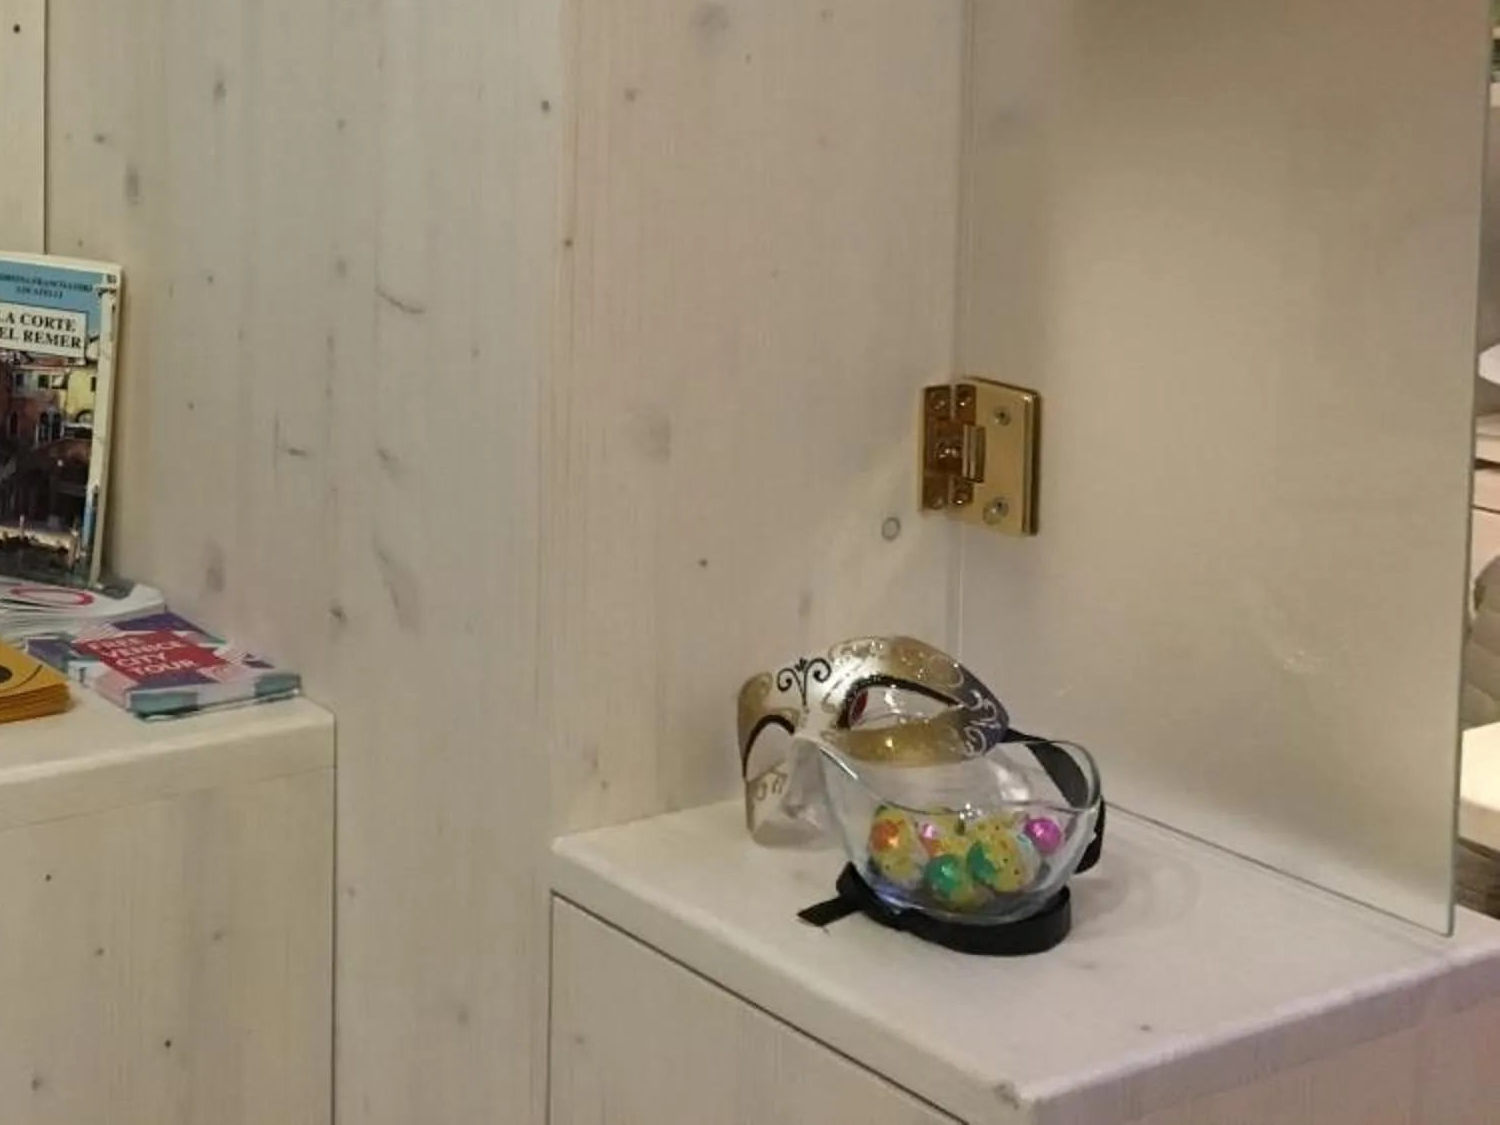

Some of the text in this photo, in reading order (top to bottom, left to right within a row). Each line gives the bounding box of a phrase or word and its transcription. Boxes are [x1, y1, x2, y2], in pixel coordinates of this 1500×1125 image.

[19, 313, 77, 333] CORTE
[22, 329, 82, 349] REMER
[100, 640, 188, 658] VENICE
[115, 652, 166, 667] CITY
[127, 659, 197, 676] TOUR
